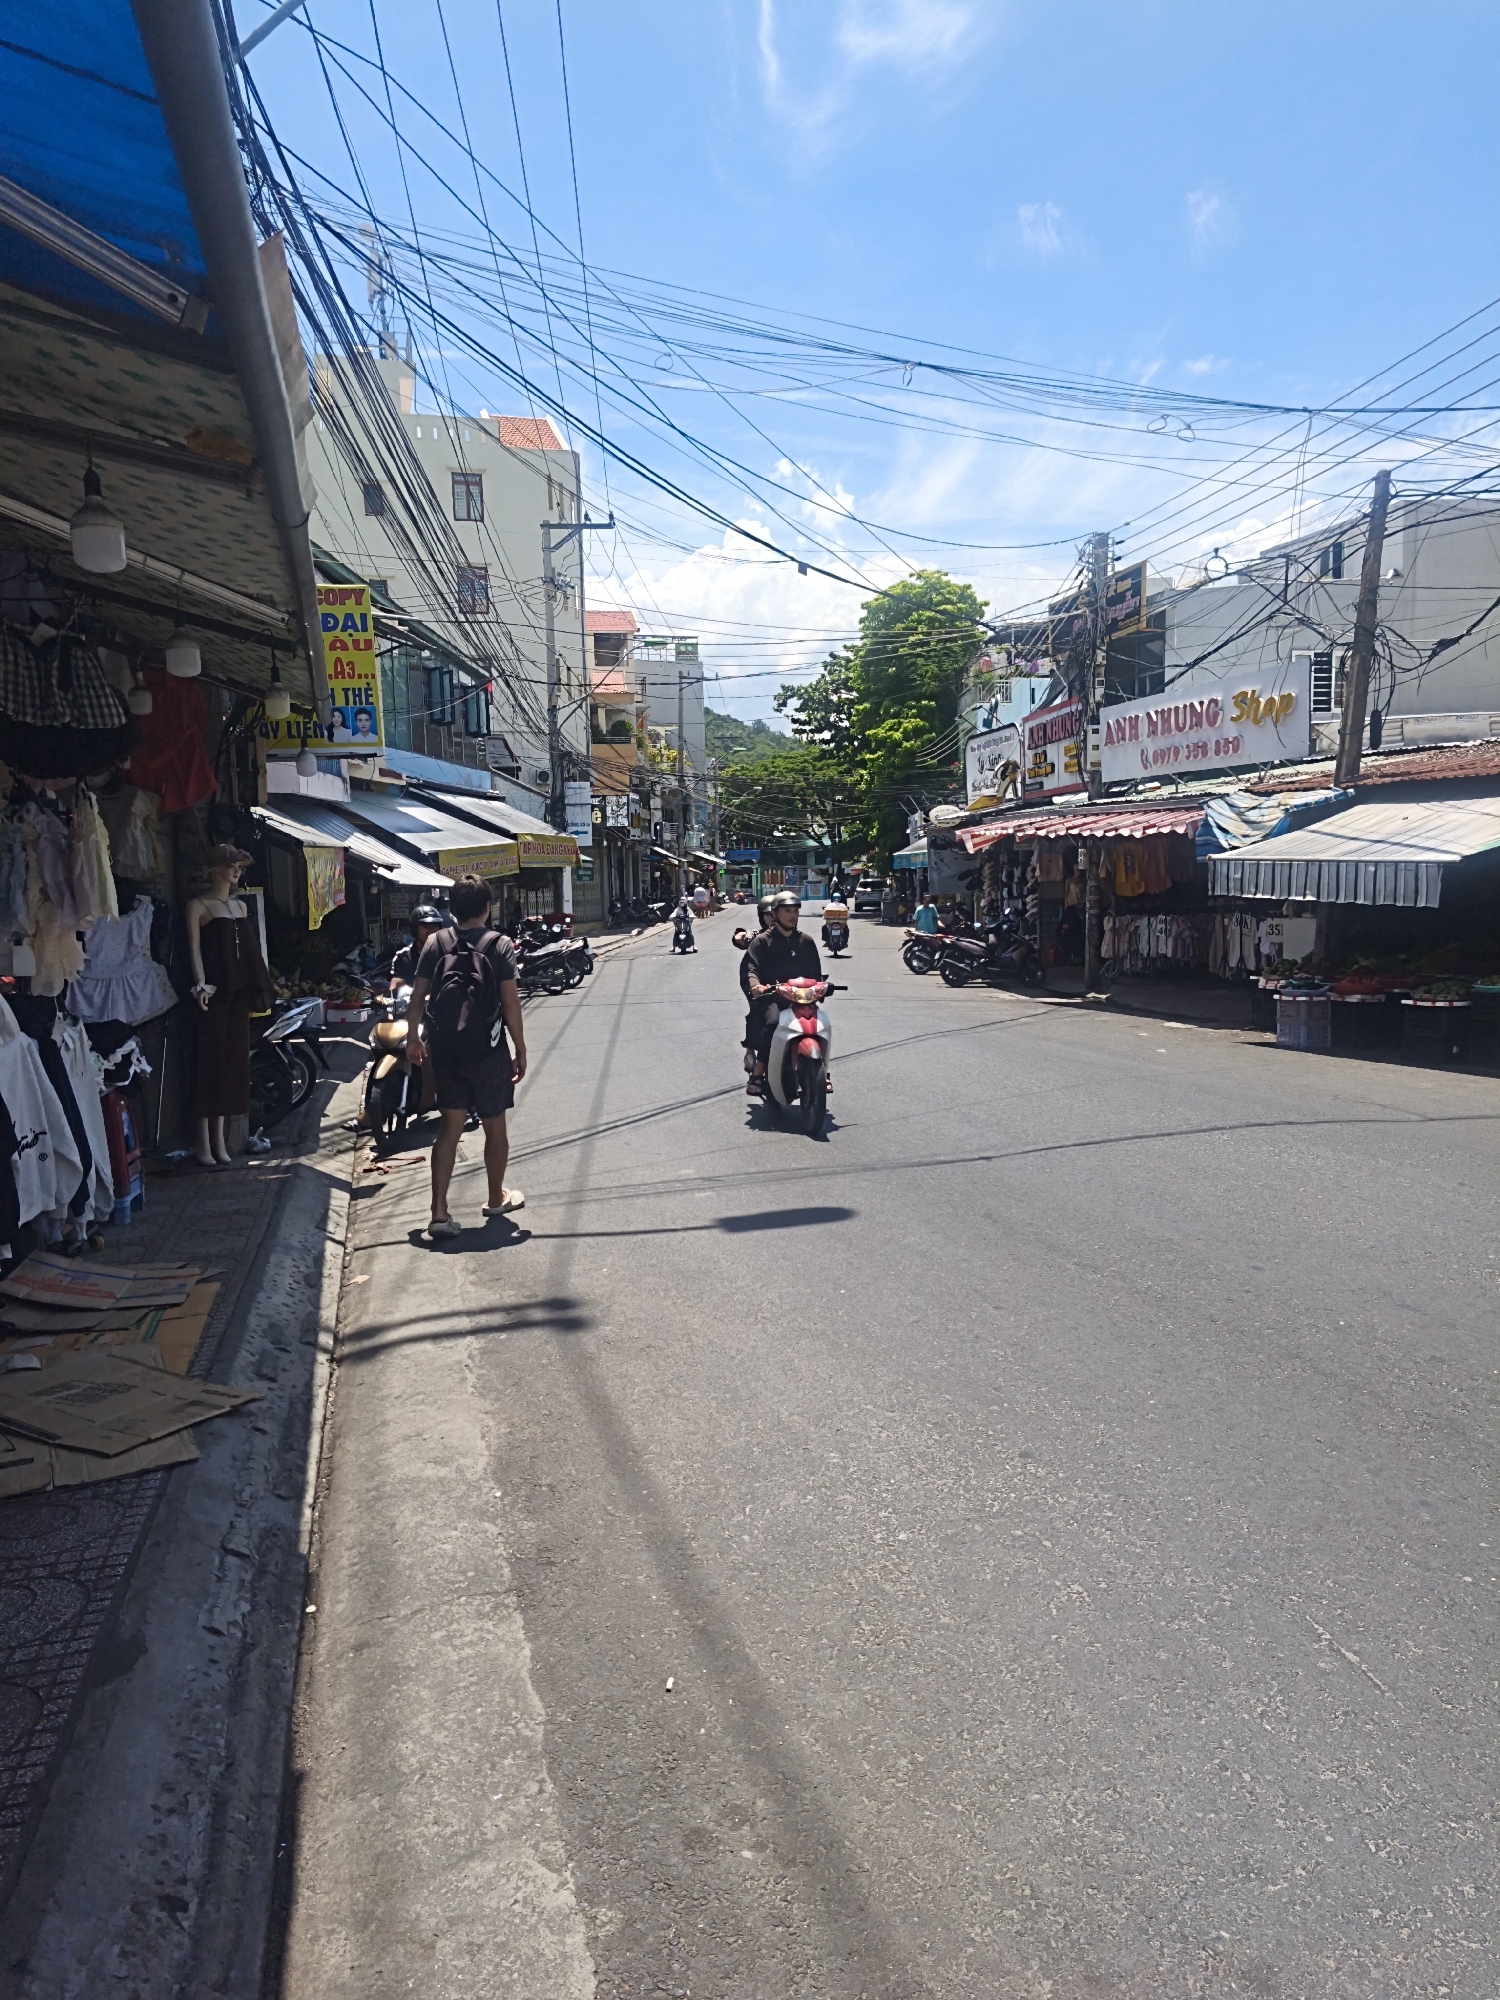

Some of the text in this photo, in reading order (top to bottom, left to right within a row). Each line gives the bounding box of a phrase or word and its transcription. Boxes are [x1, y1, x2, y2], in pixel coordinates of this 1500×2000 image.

[323, 636, 373, 652] ÀU
[342, 682, 375, 706] THẺ
[1027, 722, 1046, 750] ANH
[1047, 710, 1080, 744] NHUNG
[1104, 689, 1297, 747] ANH NHUNG Shop
[1152, 746, 1184, 766] 0979
[1185, 740, 1210, 761] 358
